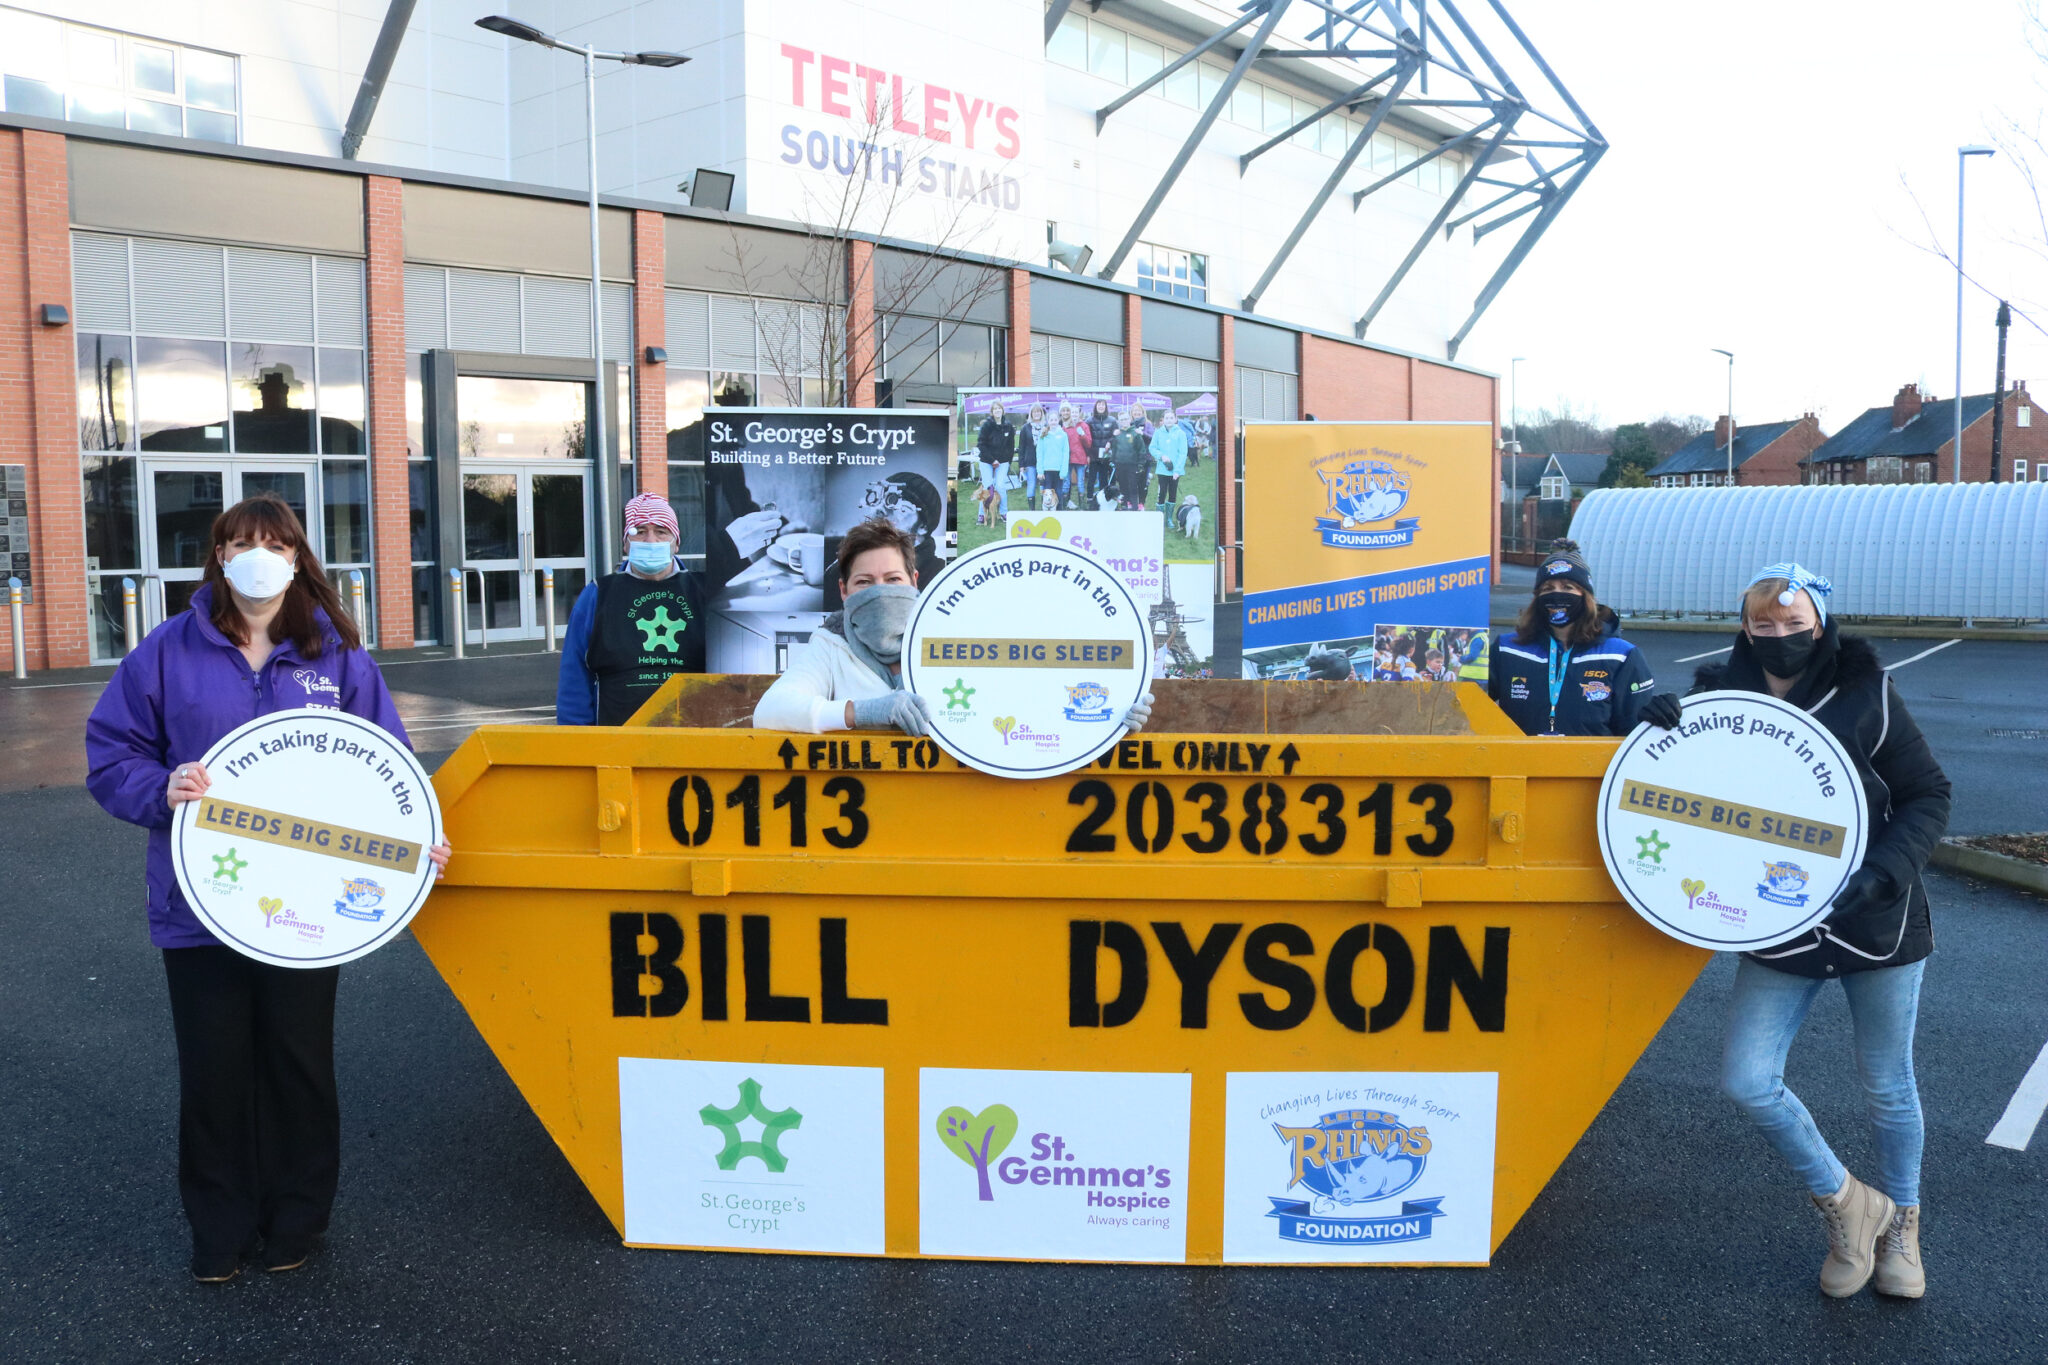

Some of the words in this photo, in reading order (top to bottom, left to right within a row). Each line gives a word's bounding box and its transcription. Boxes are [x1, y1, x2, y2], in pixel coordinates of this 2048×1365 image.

[780, 43, 1021, 160] TETLEY'S
[780, 124, 903, 188] SOUTH
[918, 156, 1021, 212] STAND
[710, 422, 738, 443] St.
[744, 422, 843, 449] George's
[850, 423, 915, 450] Crypt
[710, 451, 771, 467] Building
[775, 455, 783, 464] a
[788, 452, 833, 465] Better
[837, 453, 886, 466] Future
[1332, 533, 1407, 545] FOUNDATION
[1106, 556, 1159, 572] ma's
[936, 589, 965, 616] I'm
[963, 558, 1023, 591] taking
[1029, 560, 1071, 580] part
[1073, 570, 1091, 591] in
[1092, 586, 1117, 618] the
[1125, 575, 1159, 589] spice
[633, 590, 675, 607] George's
[676, 596, 694, 620] Crypt
[1248, 598, 1322, 625] CHANGING
[1326, 590, 1366, 612] LIVES
[1369, 577, 1436, 604] THROUGH
[1439, 568, 1486, 592] SPORT
[639, 656, 668, 665] Helping
[670, 657, 684, 665] the
[929, 643, 999, 660] LEEDS
[1008, 645, 1046, 660] BIG
[1056, 645, 1123, 662] SLEEP
[319, 676, 332, 685] St.
[1010, 731, 1060, 741] Gemma's
[1019, 724, 1032, 733] St.
[808, 740, 882, 769] FILL
[890, 740, 940, 769] TO
[1080, 740, 1162, 769] VEL
[1173, 741, 1271, 772] ONLY
[1645, 734, 1678, 761] I'm
[1676, 712, 1745, 739] taking
[1749, 718, 1796, 747] part
[1794, 740, 1815, 763] in
[1812, 762, 1836, 798] the
[225, 749, 259, 778] I'm
[259, 730, 328, 753] taking
[332, 734, 377, 766] part
[376, 759, 394, 781] in
[392, 781, 413, 816] the
[667, 775, 870, 849] 0113
[1065, 780, 1455, 858] 2038313
[1629, 787, 1702, 818] LEEDS
[1711, 805, 1752, 830] BIG
[1760, 817, 1834, 847] SLEEP
[206, 804, 282, 835] LEEDS
[290, 824, 331, 847] BIG
[339, 834, 409, 863] SLEEP
[1706, 891, 1720, 902] St.
[285, 909, 298, 920] St.
[1696, 897, 1748, 917] Gemma's
[273, 914, 324, 933] Gemma's
[610, 911, 889, 1027] BILL
[1068, 920, 1511, 1034] DYSON
[1260, 1093, 1321, 1121] Changing
[1326, 1088, 1358, 1101] Lives
[1363, 1087, 1418, 1108] Through
[1421, 1099, 1462, 1123] Sport
[1323, 1110, 1398, 1126] LEEDS
[1030, 1132, 1075, 1162] St.
[998, 1156, 1172, 1189] Gemma's
[1087, 1191, 1171, 1212] Hospice
[727, 1214, 780, 1234] Crypt
[1087, 1215, 1129, 1228] Always
[1132, 1216, 1170, 1230] caring
[1295, 1220, 1420, 1240] FOUNDATION
